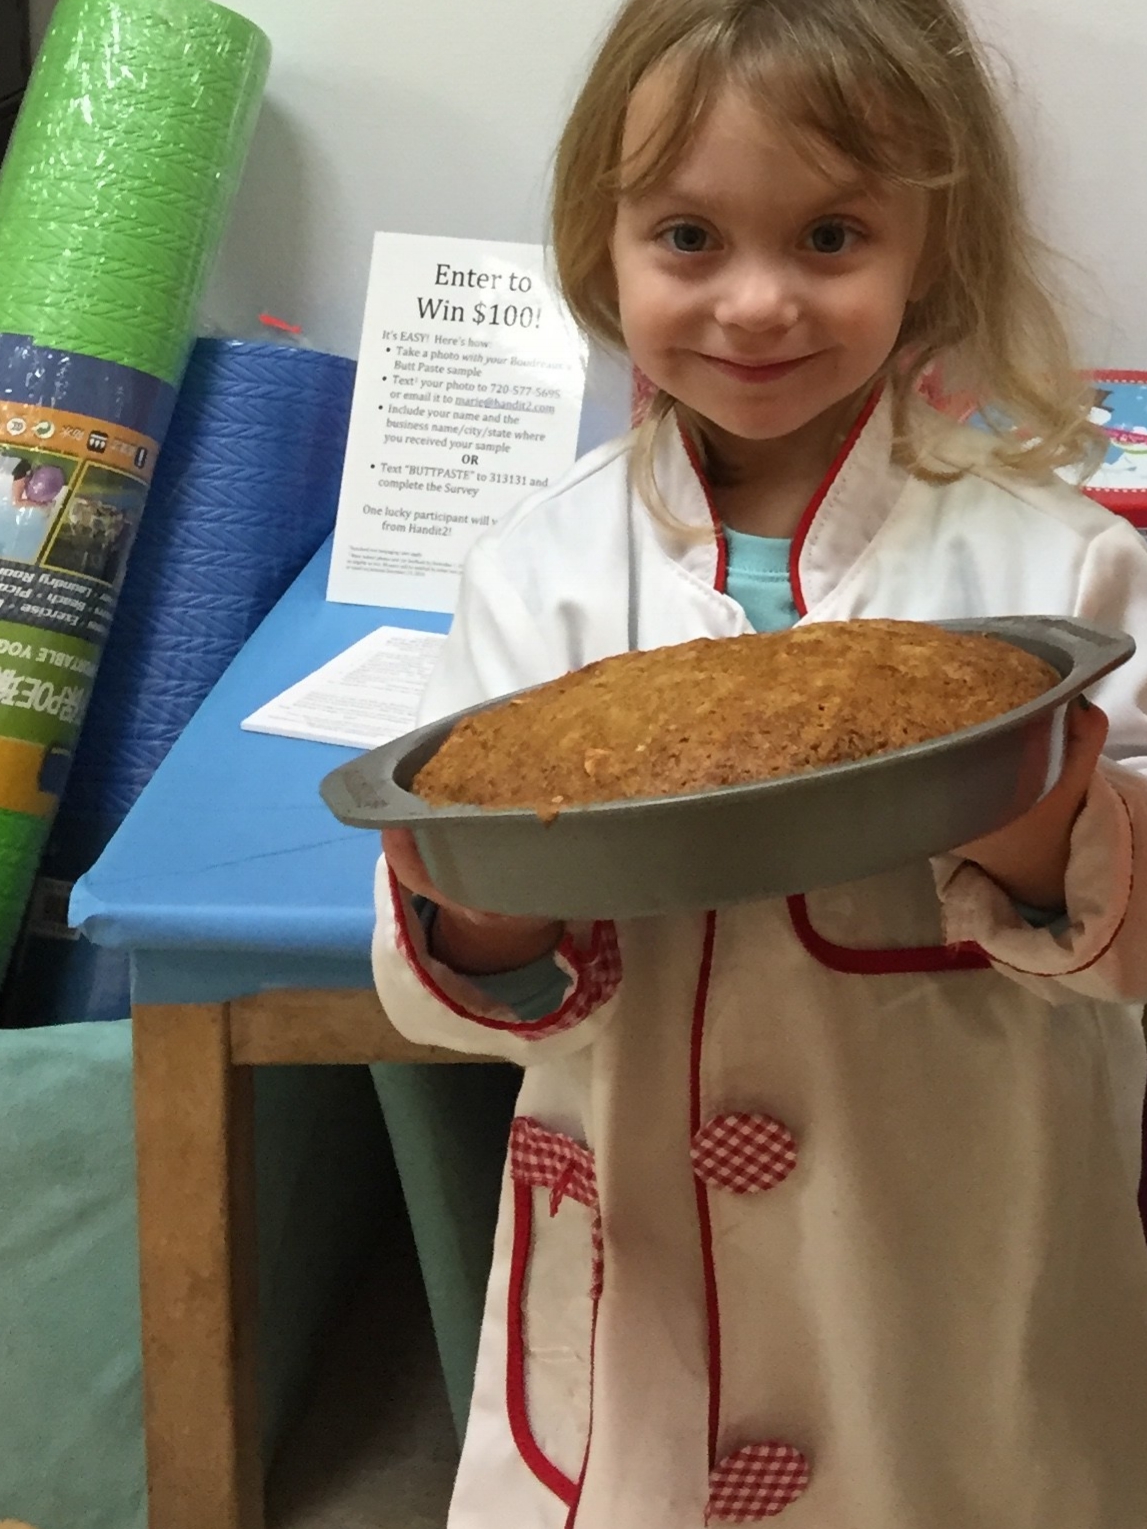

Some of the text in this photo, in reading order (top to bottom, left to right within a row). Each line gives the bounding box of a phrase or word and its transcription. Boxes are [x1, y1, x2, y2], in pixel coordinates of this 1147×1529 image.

[435, 264, 531, 292] Enter to
[417, 297, 541, 329] Win $100!
[382, 330, 397, 340] It's
[435, 335, 465, 346] Here's
[397, 346, 420, 356] Take
[431, 349, 459, 361] photo
[462, 353, 483, 362] with
[485, 355, 507, 365] your
[394, 361, 482, 377] Butt Paste sample
[421, 379, 443, 389] your
[446, 380, 475, 391] photo
[477, 384, 487, 392] to
[390, 391, 401, 399] or
[404, 392, 431, 402] email
[434, 394, 440, 403] it
[443, 395, 453, 403] to
[388, 405, 519, 424] Include your name and the
[387, 419, 546, 441] business name/city/state where
[384, 434, 510, 453] you received your sample
[462, 454, 479, 465] OR
[381, 463, 402, 473] Text
[477, 473, 487, 481] to
[489, 472, 526, 485] 313131
[530, 477, 548, 487] and
[378, 478, 479, 498] complete the Survey
[363, 504, 489, 525] One lucky participant will
[382, 521, 406, 532] from
[20, 603, 79, 626] Exercise
